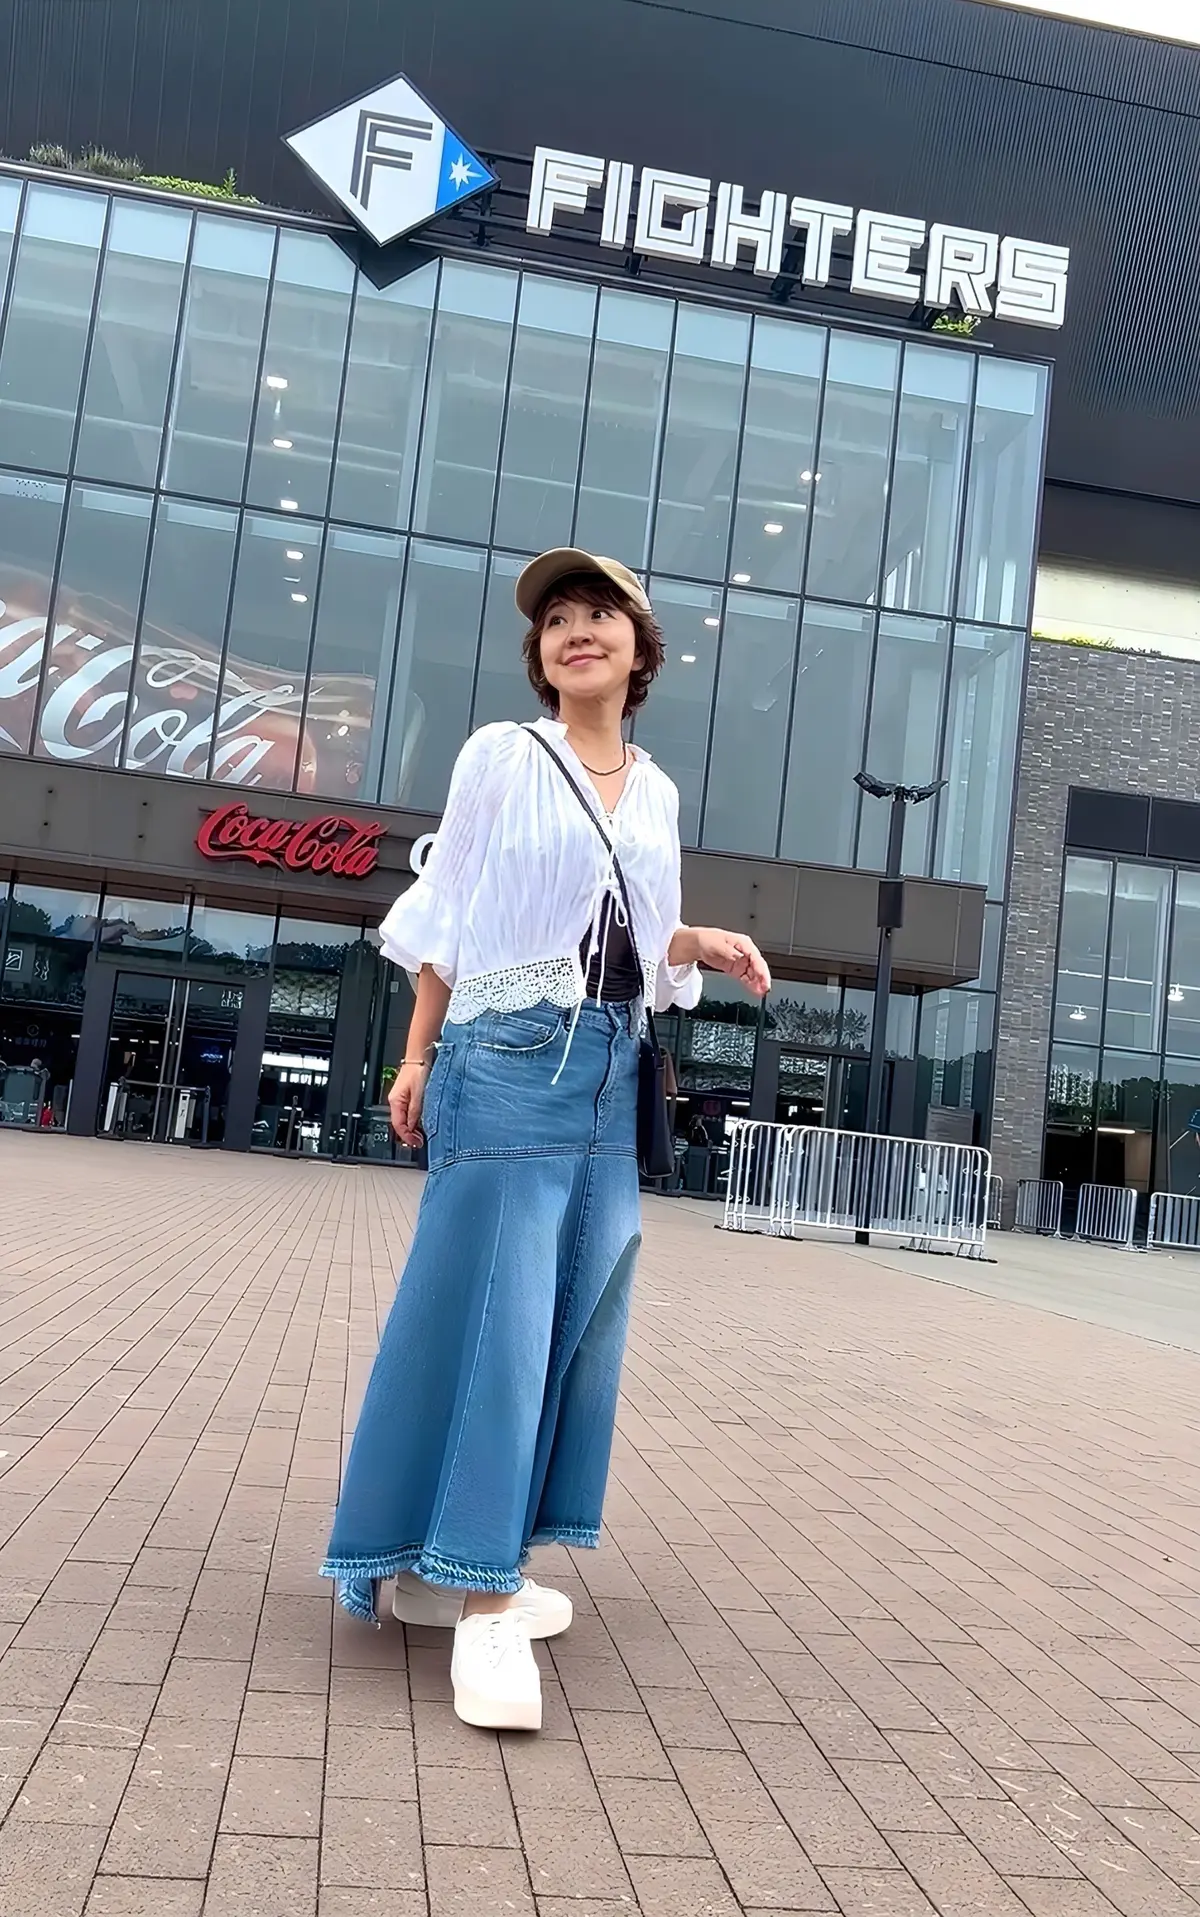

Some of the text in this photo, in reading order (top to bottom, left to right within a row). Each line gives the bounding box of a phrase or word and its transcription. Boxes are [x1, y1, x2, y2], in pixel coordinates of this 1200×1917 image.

[350, 109, 433, 211] F
[525, 145, 1070, 329] FIGHTERS
[0, 597, 323, 786] a-Cola
[197, 802, 391, 877] Coca-Cola
